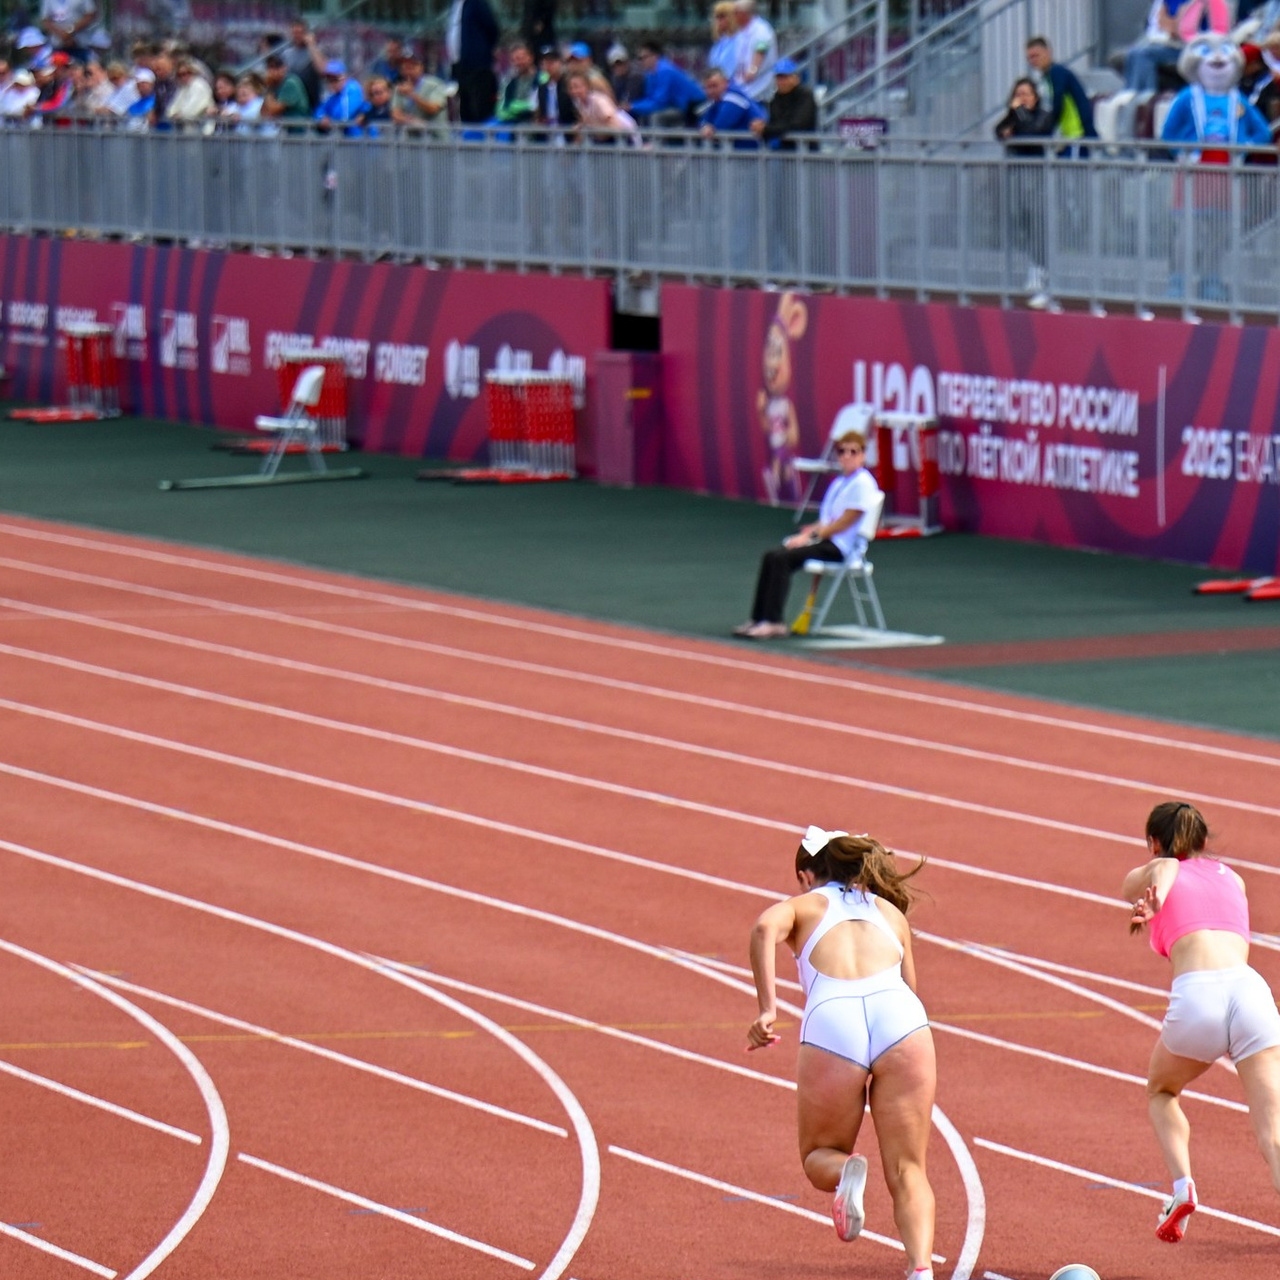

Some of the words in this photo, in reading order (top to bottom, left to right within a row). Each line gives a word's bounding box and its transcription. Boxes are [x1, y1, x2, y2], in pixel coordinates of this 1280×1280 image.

[936, 371, 1057, 428] ПЕРВЕНСТВО
[1058, 382, 1140, 437] РОССИИ
[966, 423, 1041, 485] ЛЁГКОЙ
[1042, 441, 1141, 498] АТЛЕТИКЕ
[1181, 425, 1233, 481] 2025
